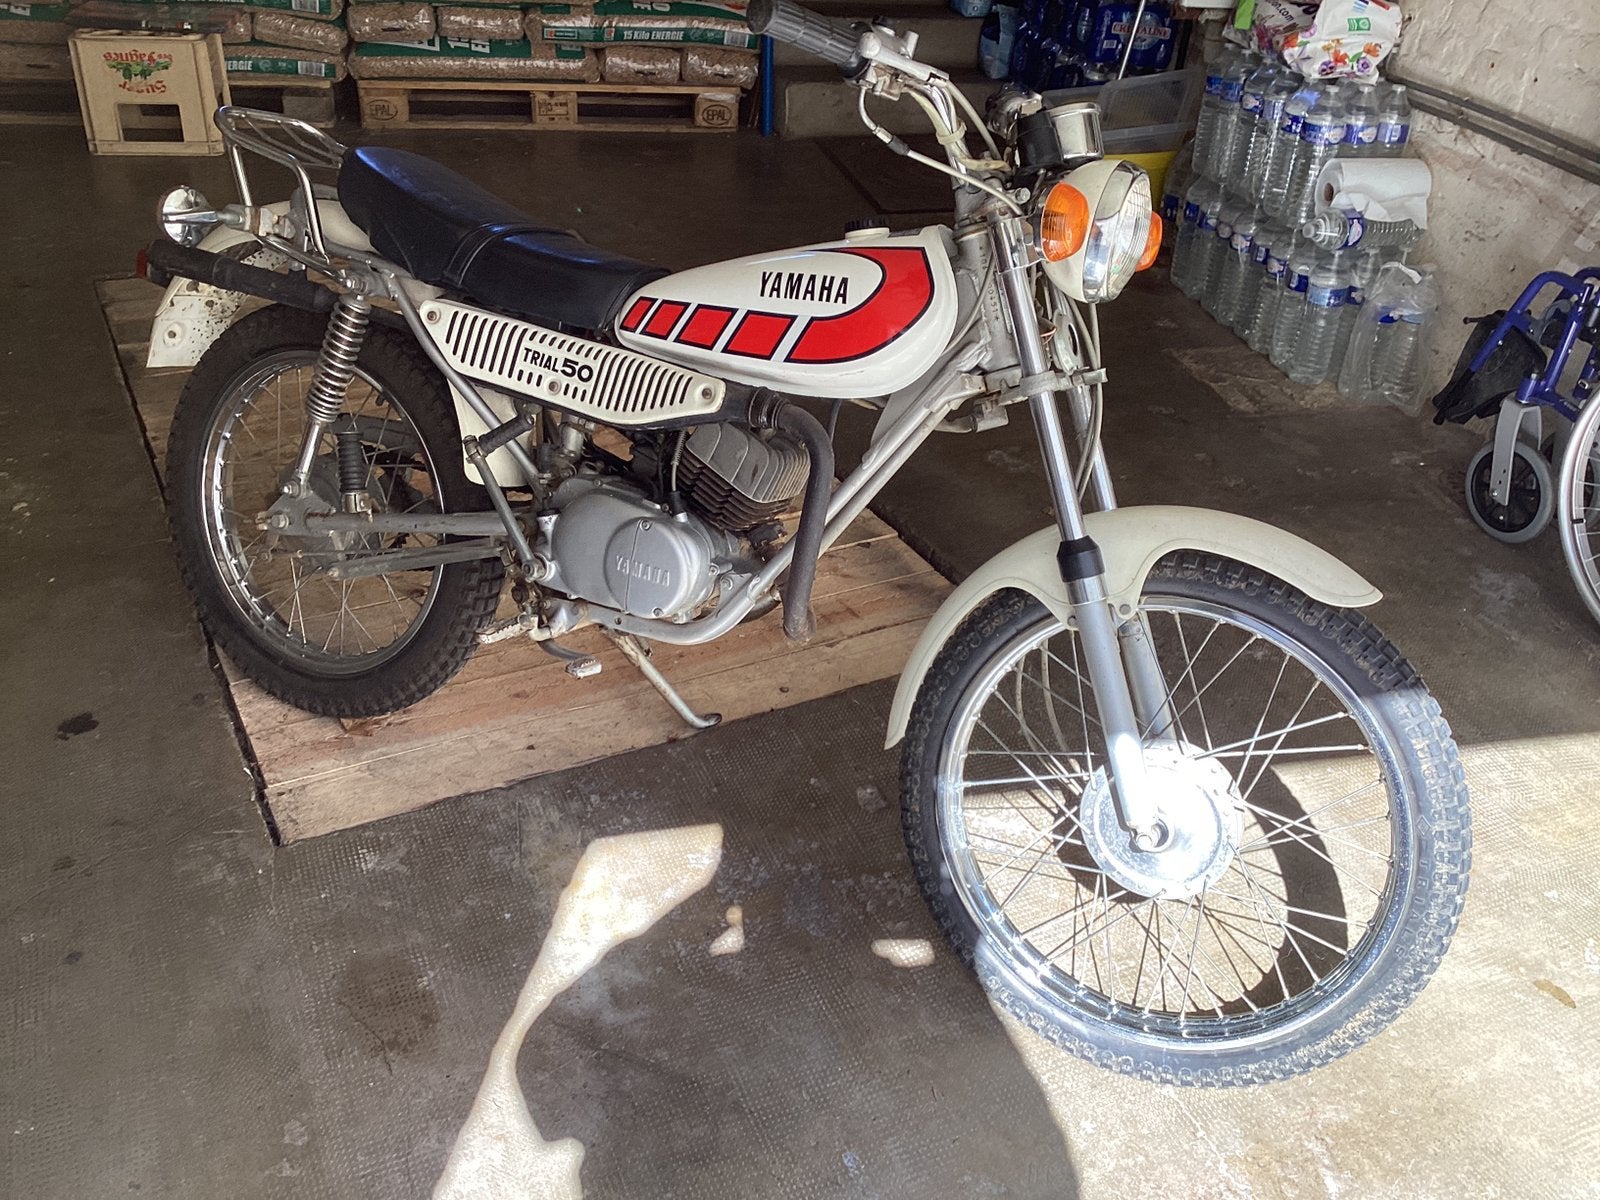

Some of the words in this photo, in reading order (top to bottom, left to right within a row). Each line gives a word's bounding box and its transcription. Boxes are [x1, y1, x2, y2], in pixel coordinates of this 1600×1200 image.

[623, 30, 633, 40] 15
[633, 30, 650, 40] Kilo
[650, 30, 684, 41] ENERGIE
[1112, 24, 1170, 39] CRITALINE
[369, 104, 394, 117] EPAL
[706, 109, 728, 121] EPAL
[759, 271, 849, 305] YAMAHA
[523, 347, 559, 373] TRIAL
[560, 357, 594, 383] 50
[615, 555, 671, 587] YAMAHA
[1394, 858, 1430, 960] TRIALS
